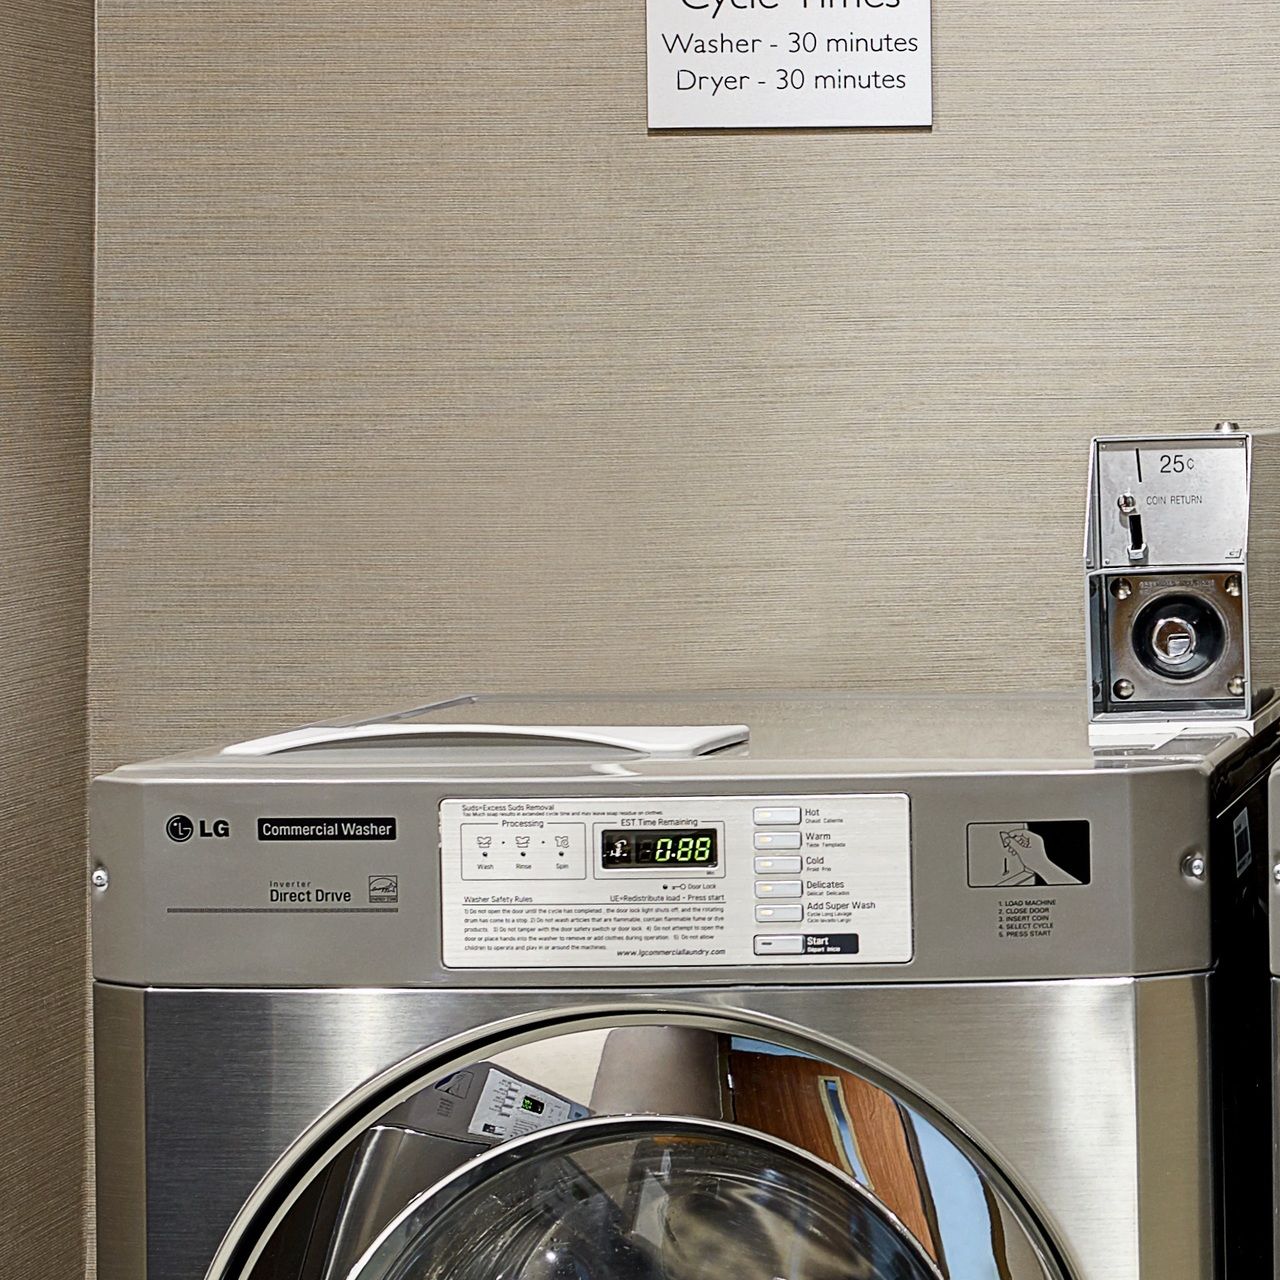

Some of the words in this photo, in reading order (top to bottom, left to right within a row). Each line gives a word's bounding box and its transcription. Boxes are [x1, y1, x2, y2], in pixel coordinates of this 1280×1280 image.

[661, 33, 762, 54] Washer
[788, 32, 817, 53] 30
[827, 32, 918, 52] minutes
[677, 69, 750, 96] Dryer
[776, 69, 805, 90] 30
[815, 69, 906, 89] minutes
[1146, 495, 1166, 506] COIN
[1170, 495, 1202, 505] RETURN
[502, 819, 544, 829] Processing
[658, 818, 698, 827] Remaining
[199, 820, 230, 837] LG
[263, 823, 338, 836] Commercial
[341, 823, 392, 835] Washer
[805, 832, 831, 840] Warm
[806, 856, 824, 865] Cold
[477, 863, 494, 871] Wash
[806, 880, 845, 889] Delicates
[270, 889, 312, 902] Direct
[315, 889, 351, 902] Drive
[666, 894, 680, 902] load
[708, 894, 724, 902] start
[807, 902, 824, 910] Add
[825, 901, 849, 911] Super
[852, 901, 876, 909] Wash
[1005, 907, 1027, 915] CLOSE
[1029, 907, 1049, 915] DOOR
[1031, 914, 1049, 922] COIN
[1006, 930, 1028, 938] PRESS
[807, 936, 829, 945] Start
